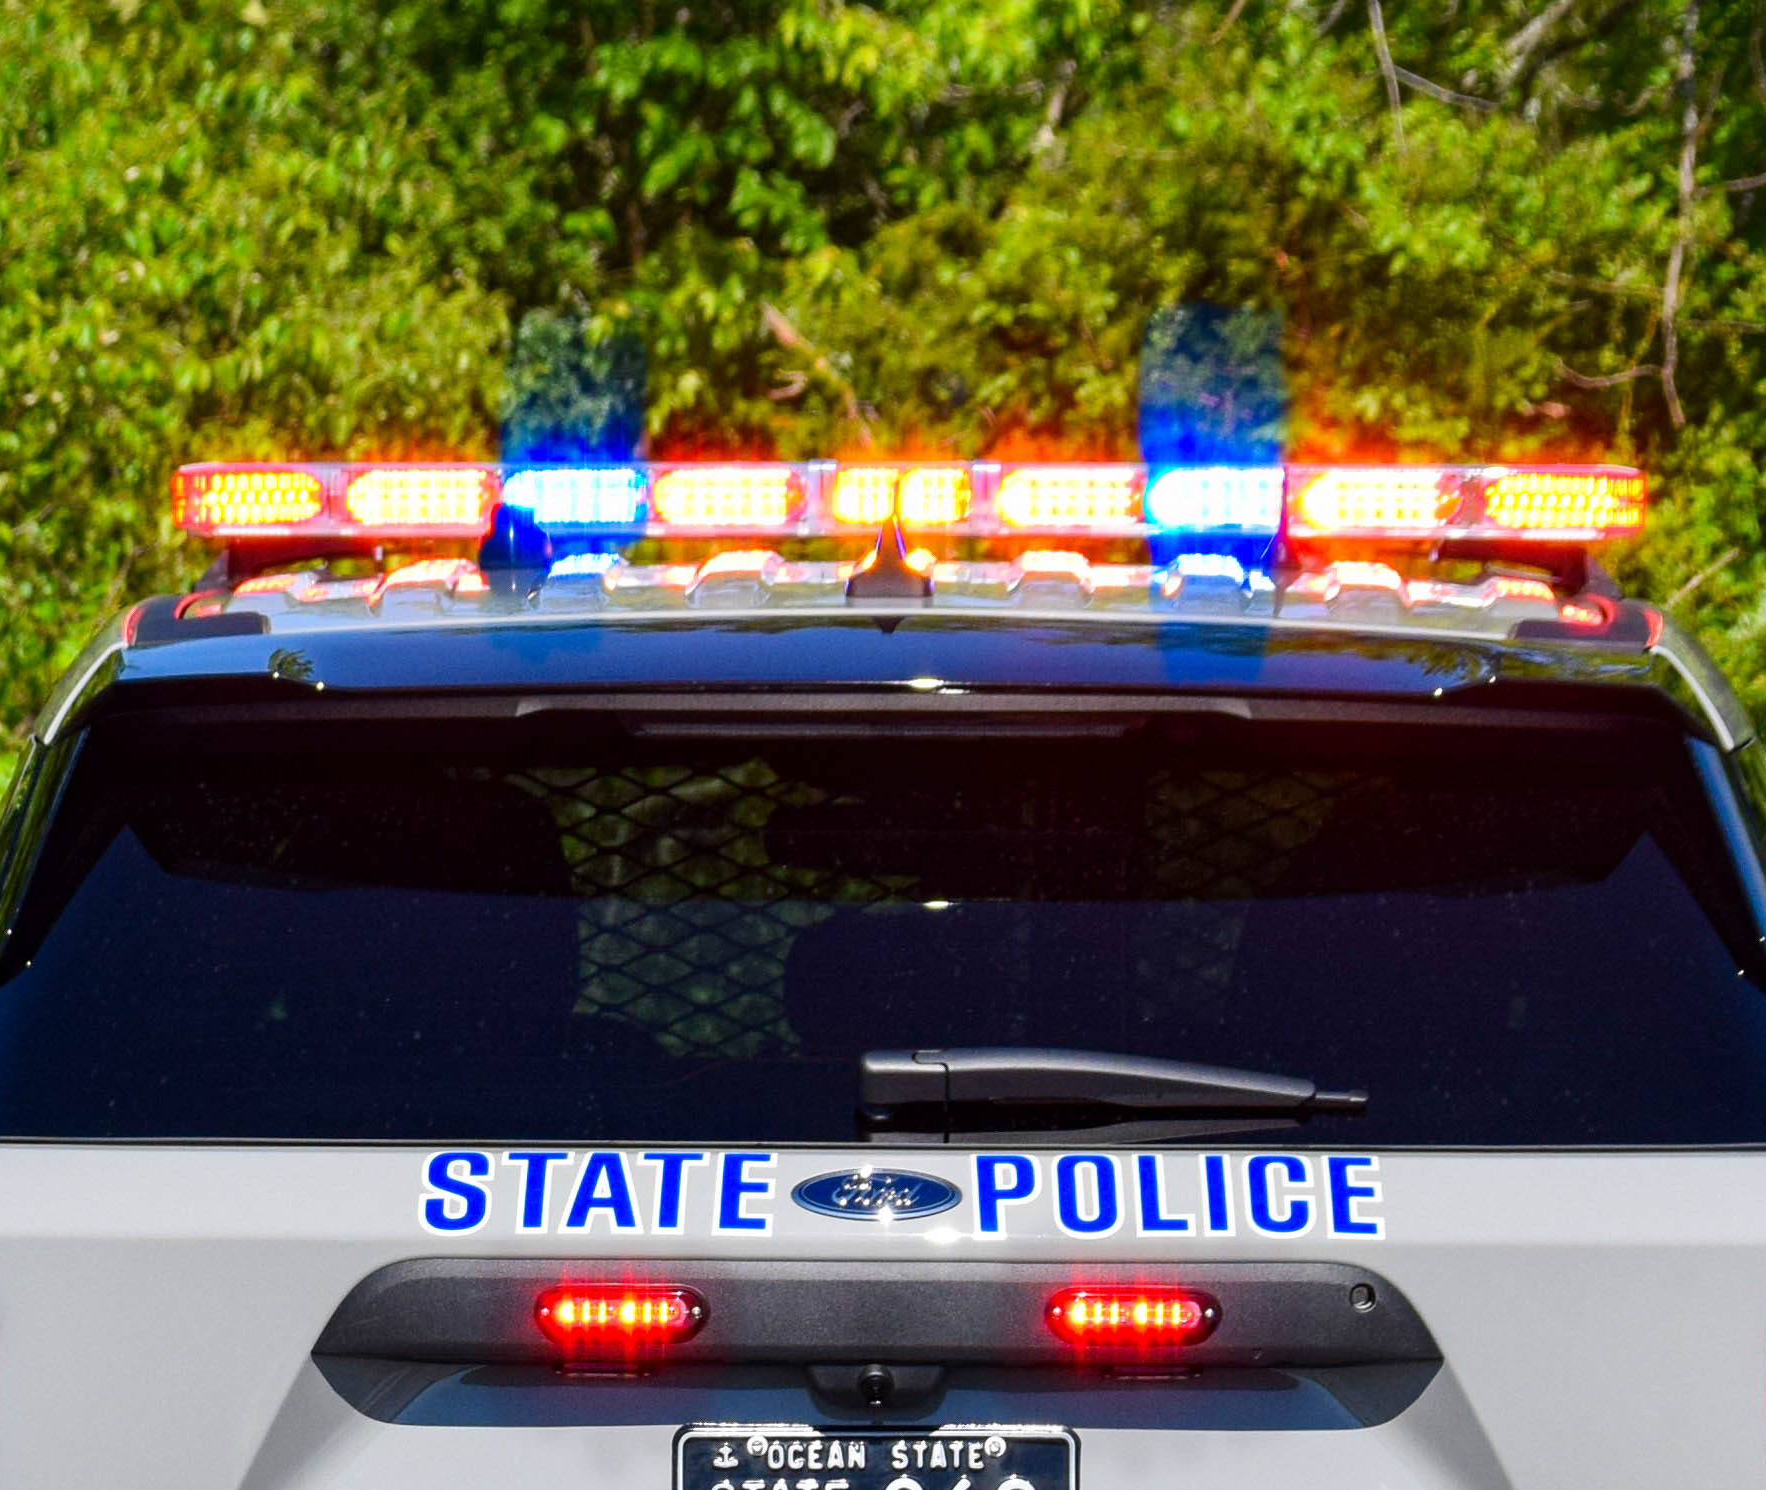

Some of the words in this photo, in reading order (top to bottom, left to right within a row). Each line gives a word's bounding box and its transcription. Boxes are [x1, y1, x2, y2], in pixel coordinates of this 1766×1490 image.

[421, 1149, 775, 1234] STATE
[973, 1152, 1384, 1237] POLICE
[767, 1440, 866, 1470] OCEAN
[891, 1440, 984, 1470] STATE
